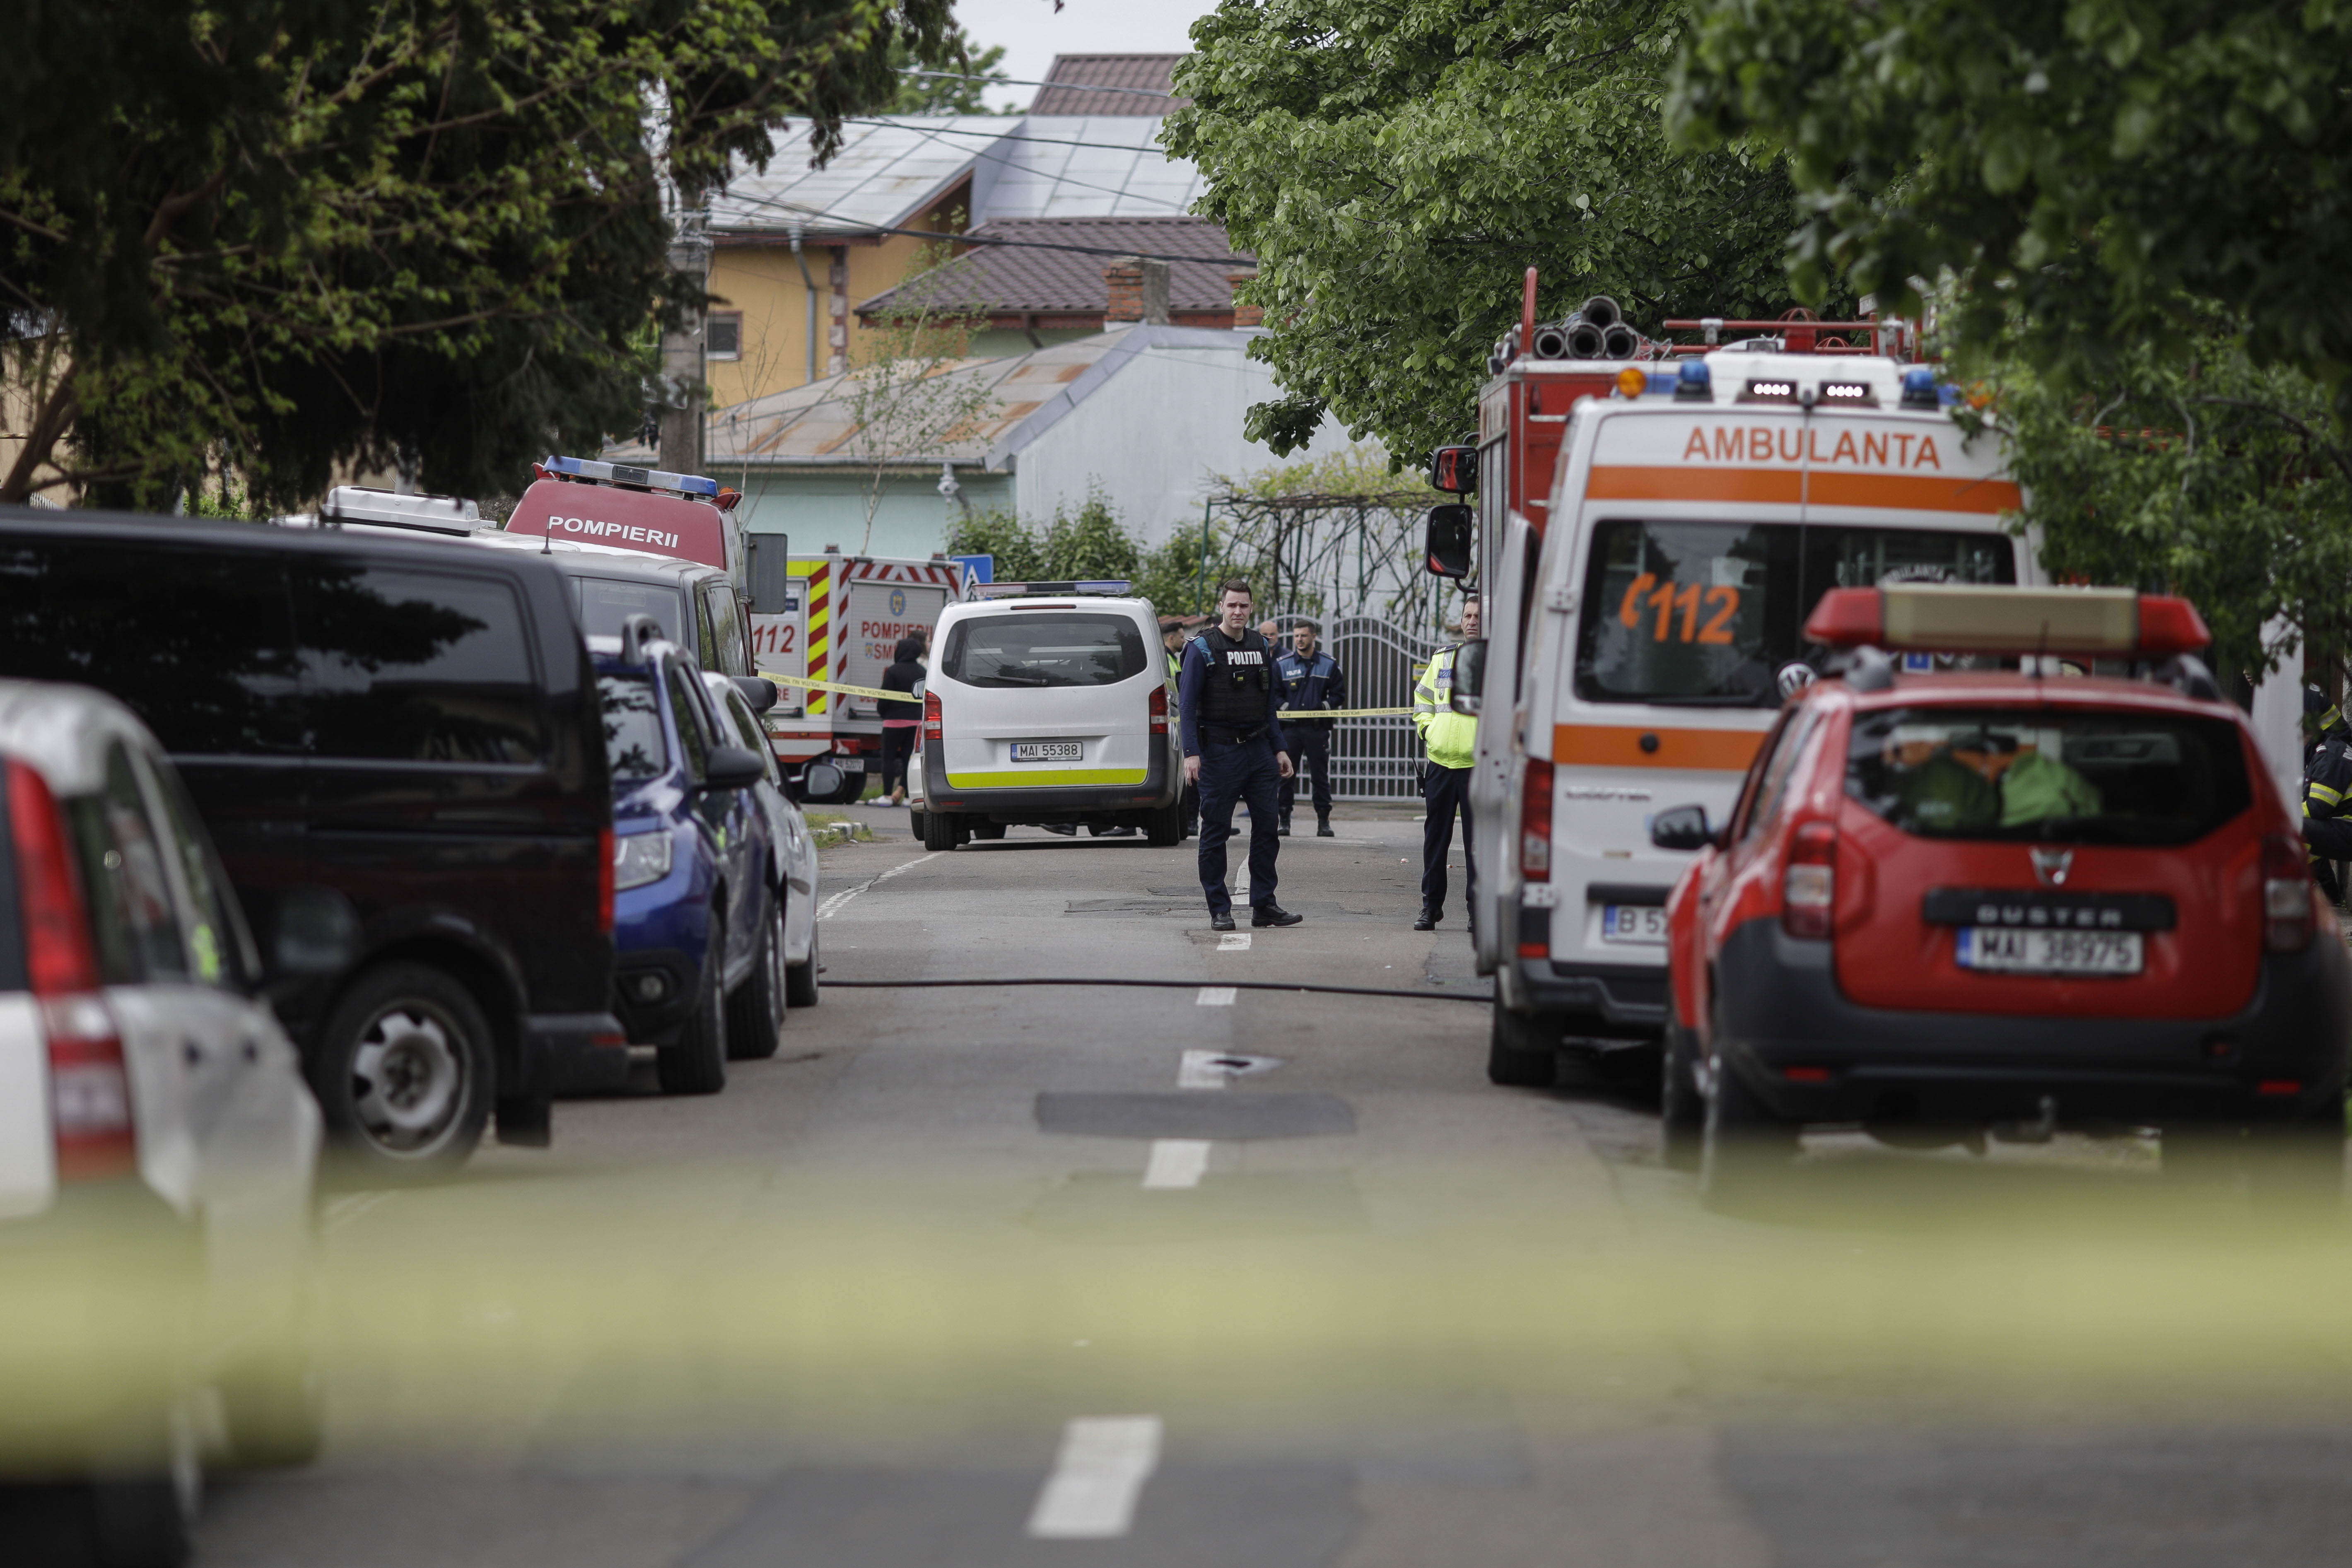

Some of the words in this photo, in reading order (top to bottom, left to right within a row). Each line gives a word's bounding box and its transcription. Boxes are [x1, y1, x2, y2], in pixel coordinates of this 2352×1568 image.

[1683, 426, 1940, 470] AMBULANTA
[547, 516, 679, 548] POMPIERII
[1648, 581, 1740, 644] 112
[753, 624, 795, 653] 112
[1227, 651, 1263, 665] POLITIA
[1020, 745, 1038, 757] MAI
[1042, 744, 1078, 756] 55388
[1981, 929, 2027, 960] MAI
